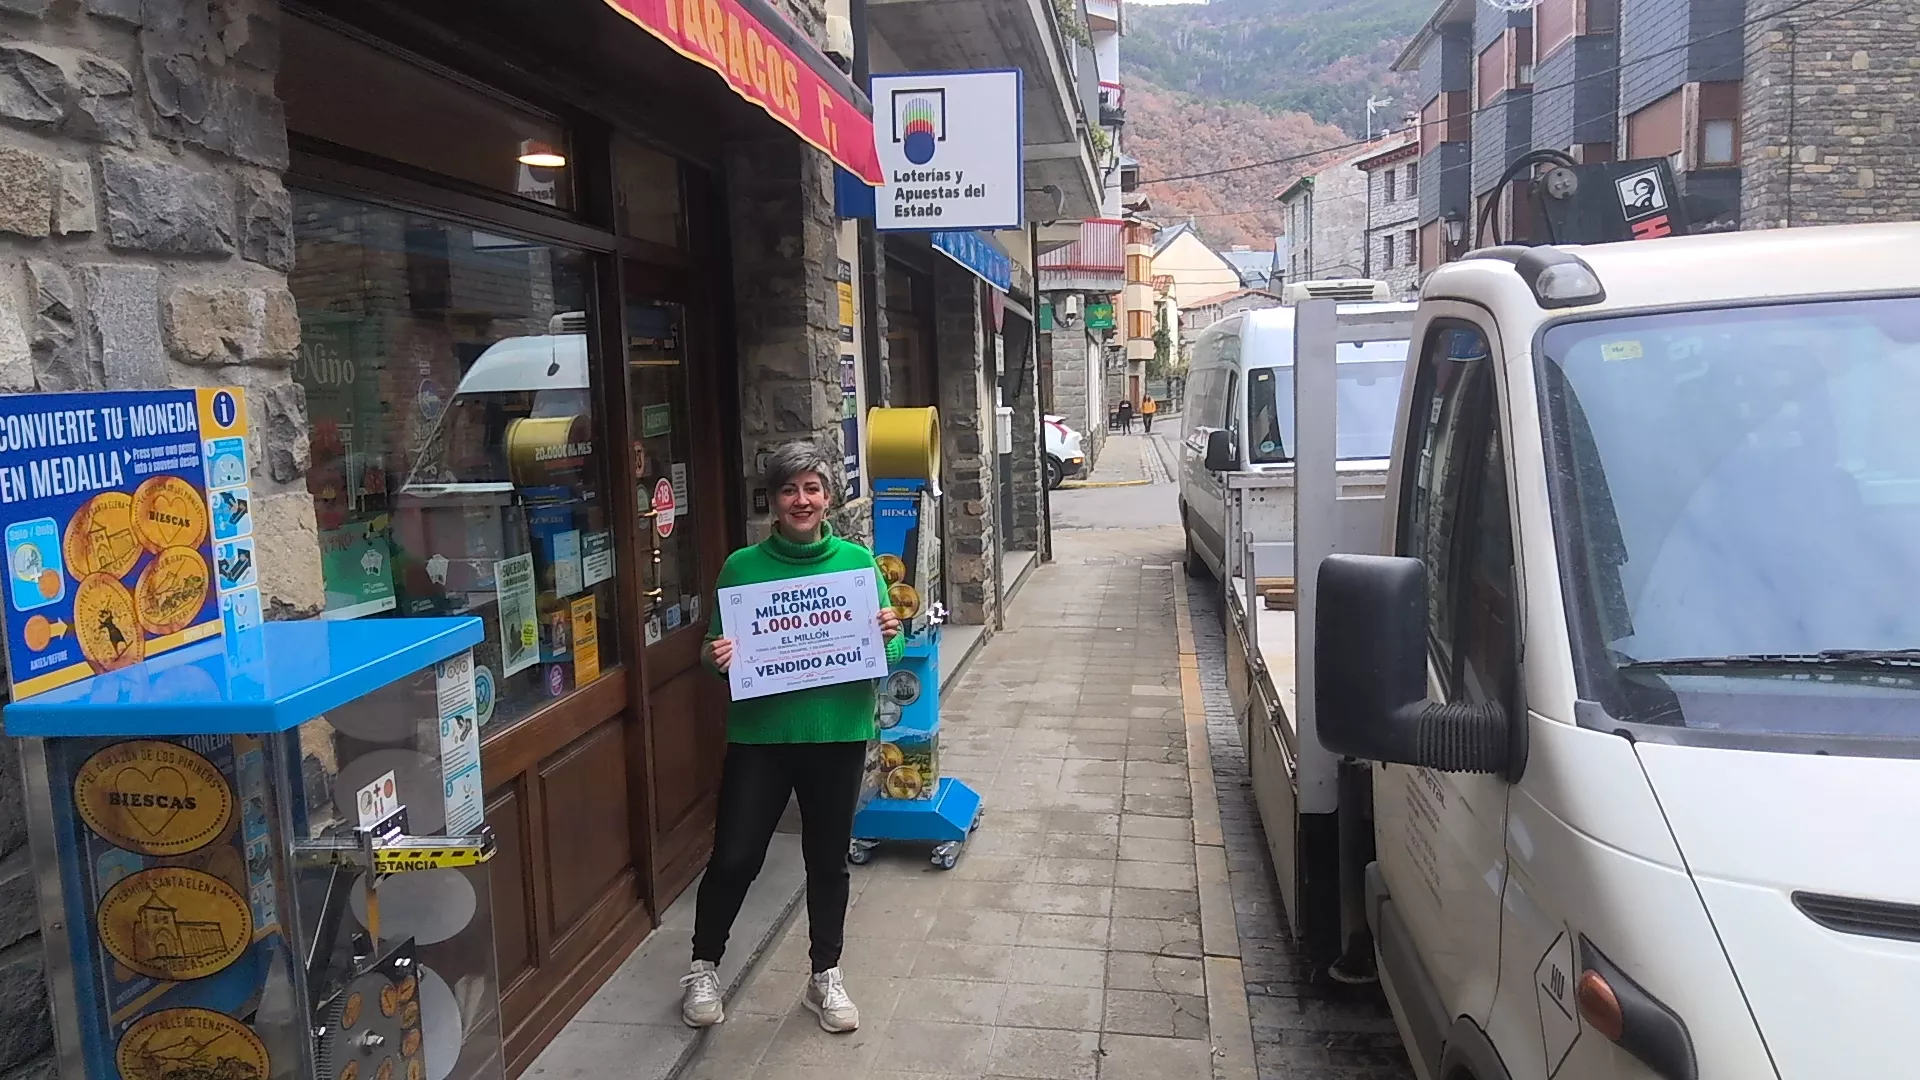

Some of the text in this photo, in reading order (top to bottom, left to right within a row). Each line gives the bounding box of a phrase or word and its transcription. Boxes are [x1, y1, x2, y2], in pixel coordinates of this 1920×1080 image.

[894, 168, 963, 184] Loterías y
[895, 184, 985, 203] Apuestas del
[894, 203, 943, 217] Estado
[0, 401, 197, 451] CONVIERTE TU MONEDA
[132, 448, 150, 460] Press
[151, 447, 164, 459] your
[178, 442, 196, 456] penny
[134, 462, 148, 474] into
[153, 457, 179, 471] souvenir
[0, 451, 124, 503] EN MEDALLA
[149, 510, 190, 528] BIESCAS
[881, 509, 918, 517] BIESCAS
[772, 586, 828, 604] PREMIO
[755, 596, 846, 619] MILLONARIO
[781, 628, 829, 645] EL MILLÓN
[755, 657, 822, 677] VENDIDO
[825, 646, 862, 666] AQUÍ
[85, 772, 98, 784] EL
[141, 749, 153, 761] DE
[155, 750, 175, 764] LOS
[178, 755, 218, 789] PIRINEOS
[108, 792, 197, 810] BIESCAS
[117, 876, 218, 904] ERMITA SANTA ELENA
[154, 1016, 223, 1033] VALLE DE TENA
